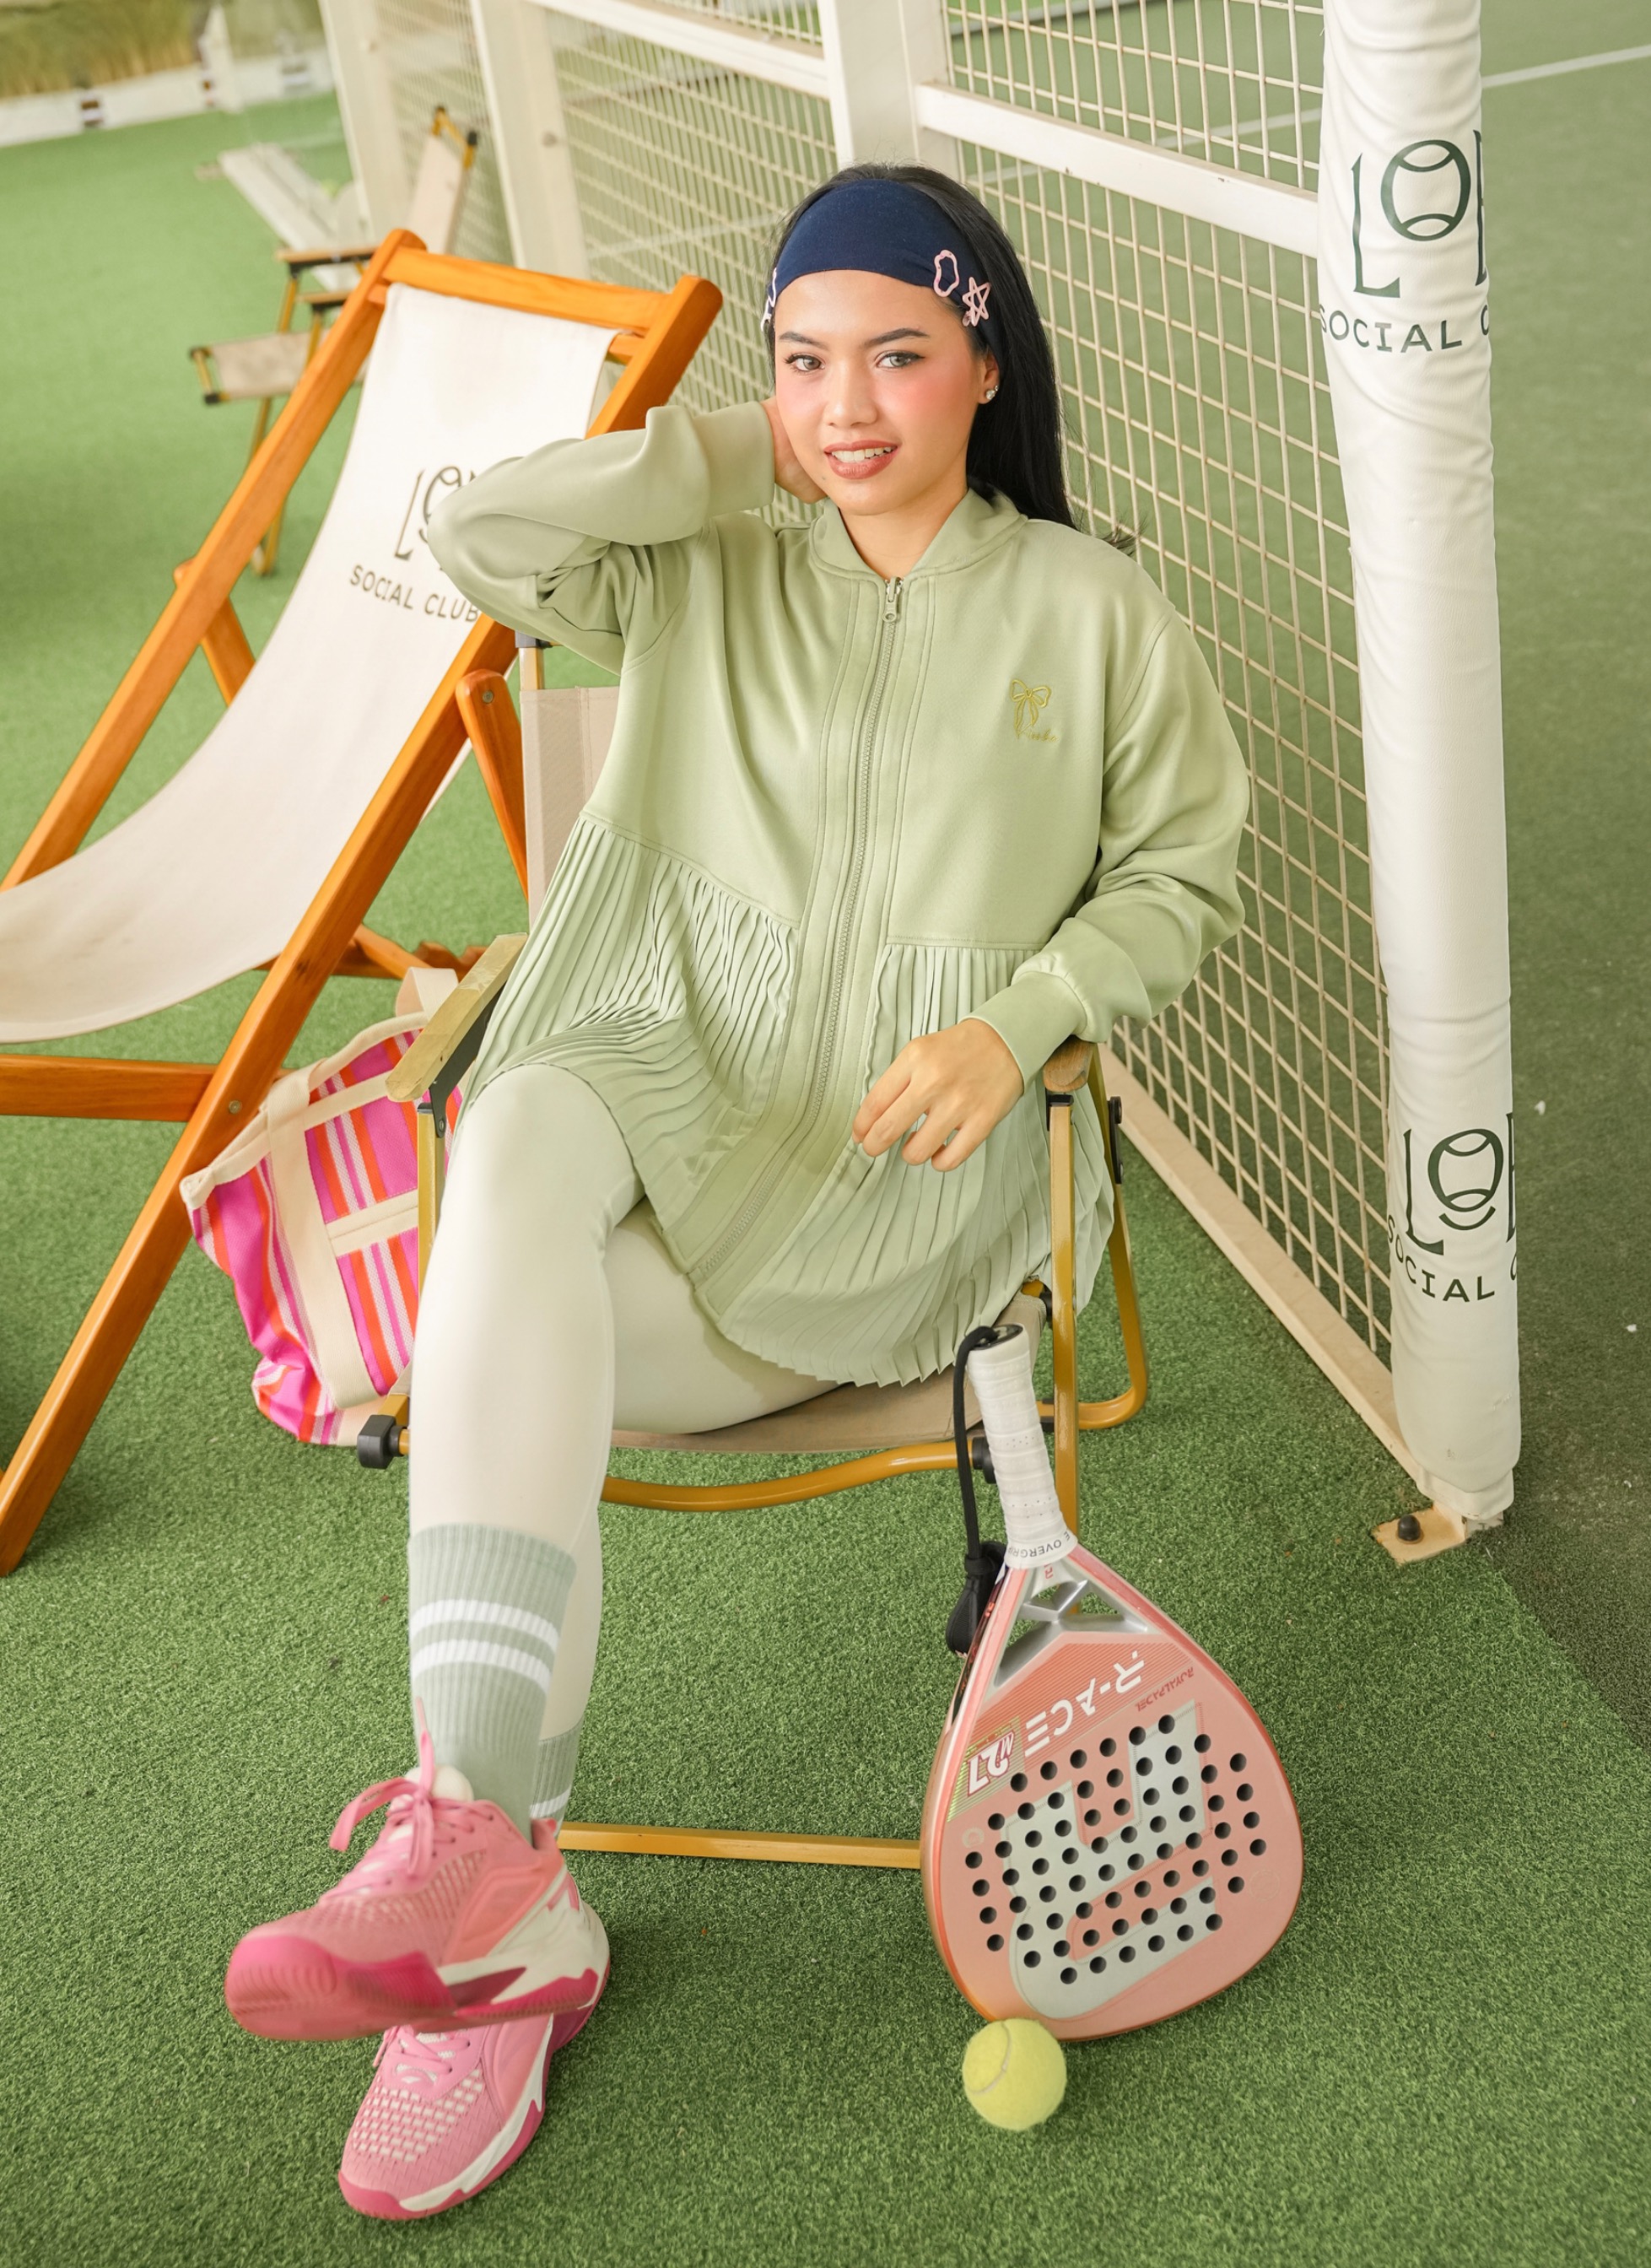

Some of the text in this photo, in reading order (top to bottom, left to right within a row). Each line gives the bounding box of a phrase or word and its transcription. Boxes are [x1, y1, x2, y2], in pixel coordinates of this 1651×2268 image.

[1350, 128, 1487, 299] LO
[1319, 303, 1463, 354] SOCIAL
[349, 564, 478, 623] SOCIAL CLUB
[1403, 1112, 1516, 1256] LO
[1387, 1214, 1496, 1303] SOCIAL
[1024, 1650, 1145, 1758] R-ACE
